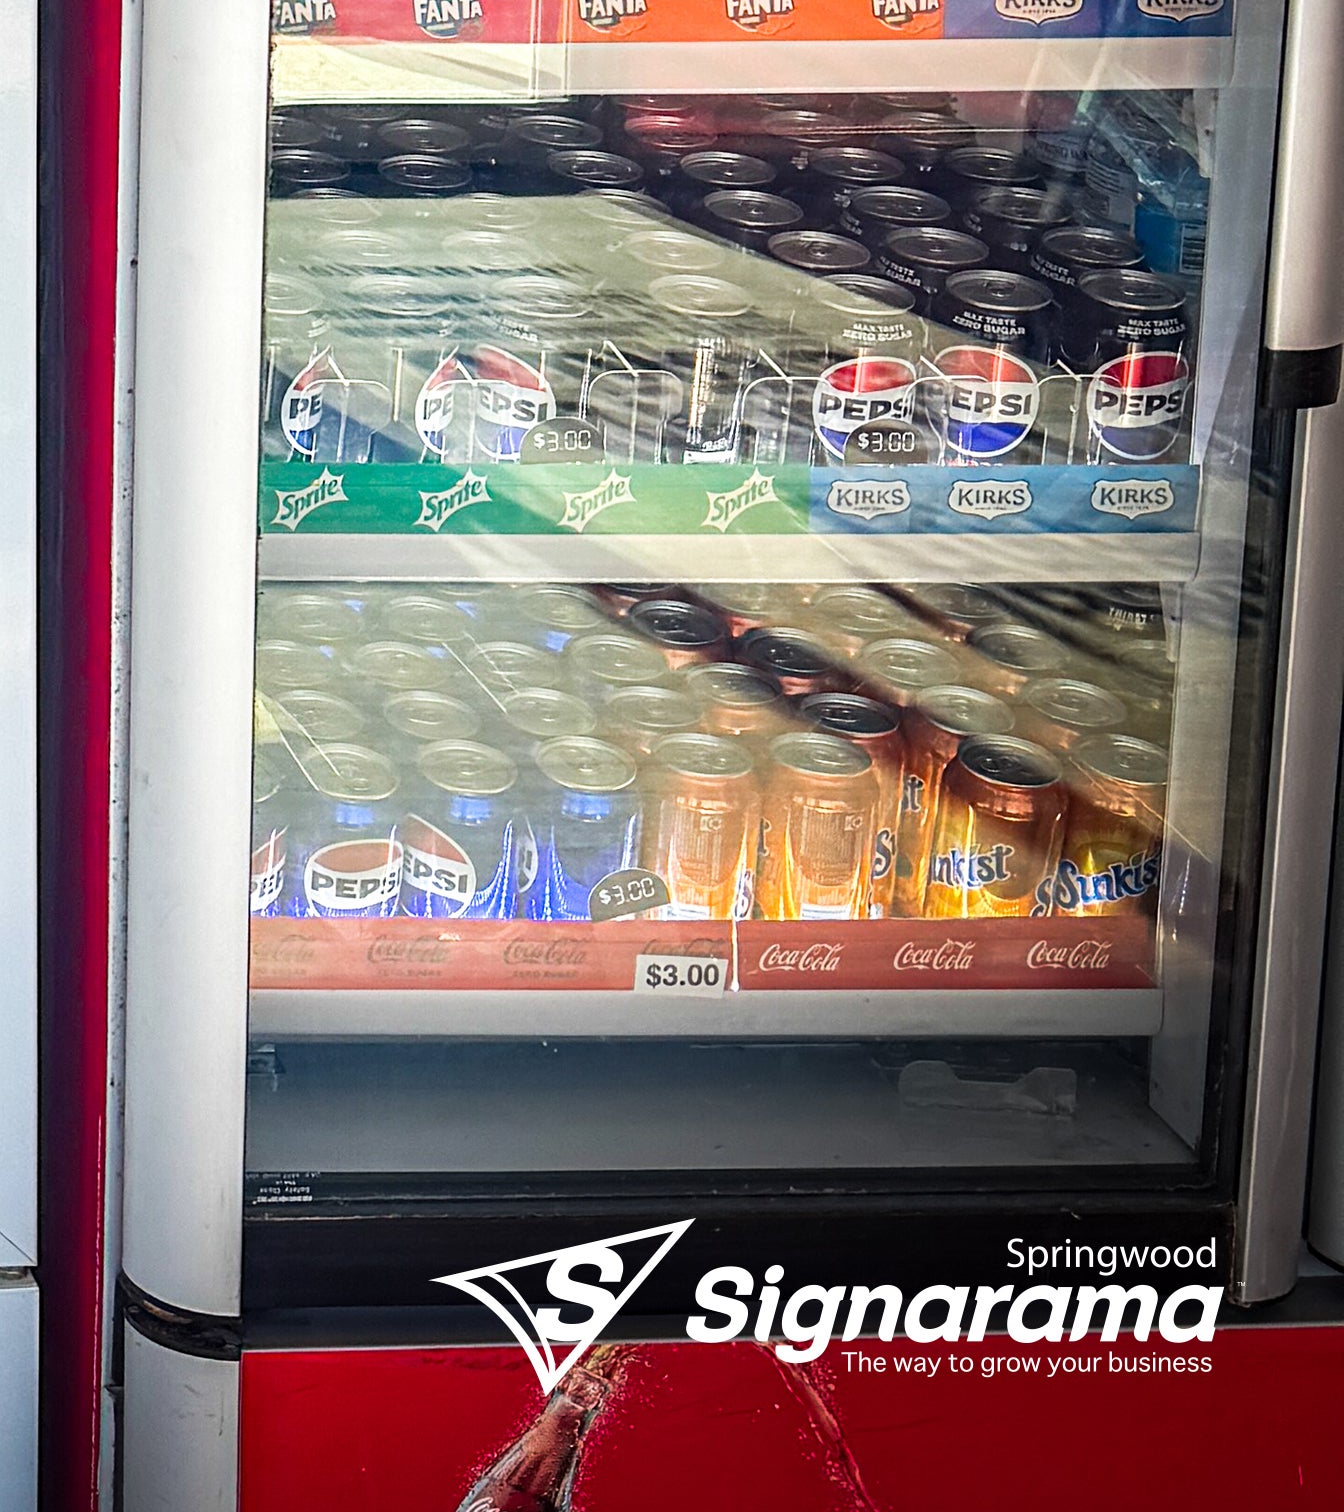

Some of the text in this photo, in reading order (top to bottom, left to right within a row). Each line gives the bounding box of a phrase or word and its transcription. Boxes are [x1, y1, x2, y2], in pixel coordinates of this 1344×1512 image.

[533, 430, 592, 452] $3.00
[857, 431, 915, 454] $3.00
[281, 477, 339, 521] Sprite
[424, 478, 483, 521] Sprite
[566, 476, 629, 521] Sprite
[710, 477, 769, 521] Sprite
[836, 488, 905, 507] KIRKS
[957, 488, 1026, 507] KIRKS
[1100, 487, 1168, 506] KIRKS
[598, 877, 656, 906] $3.00
[759, 943, 846, 972] Coca-Cola
[893, 940, 977, 971] Coca-Cola
[1027, 939, 1113, 970] Coca-Cola
[645, 963, 720, 988] $3.00
